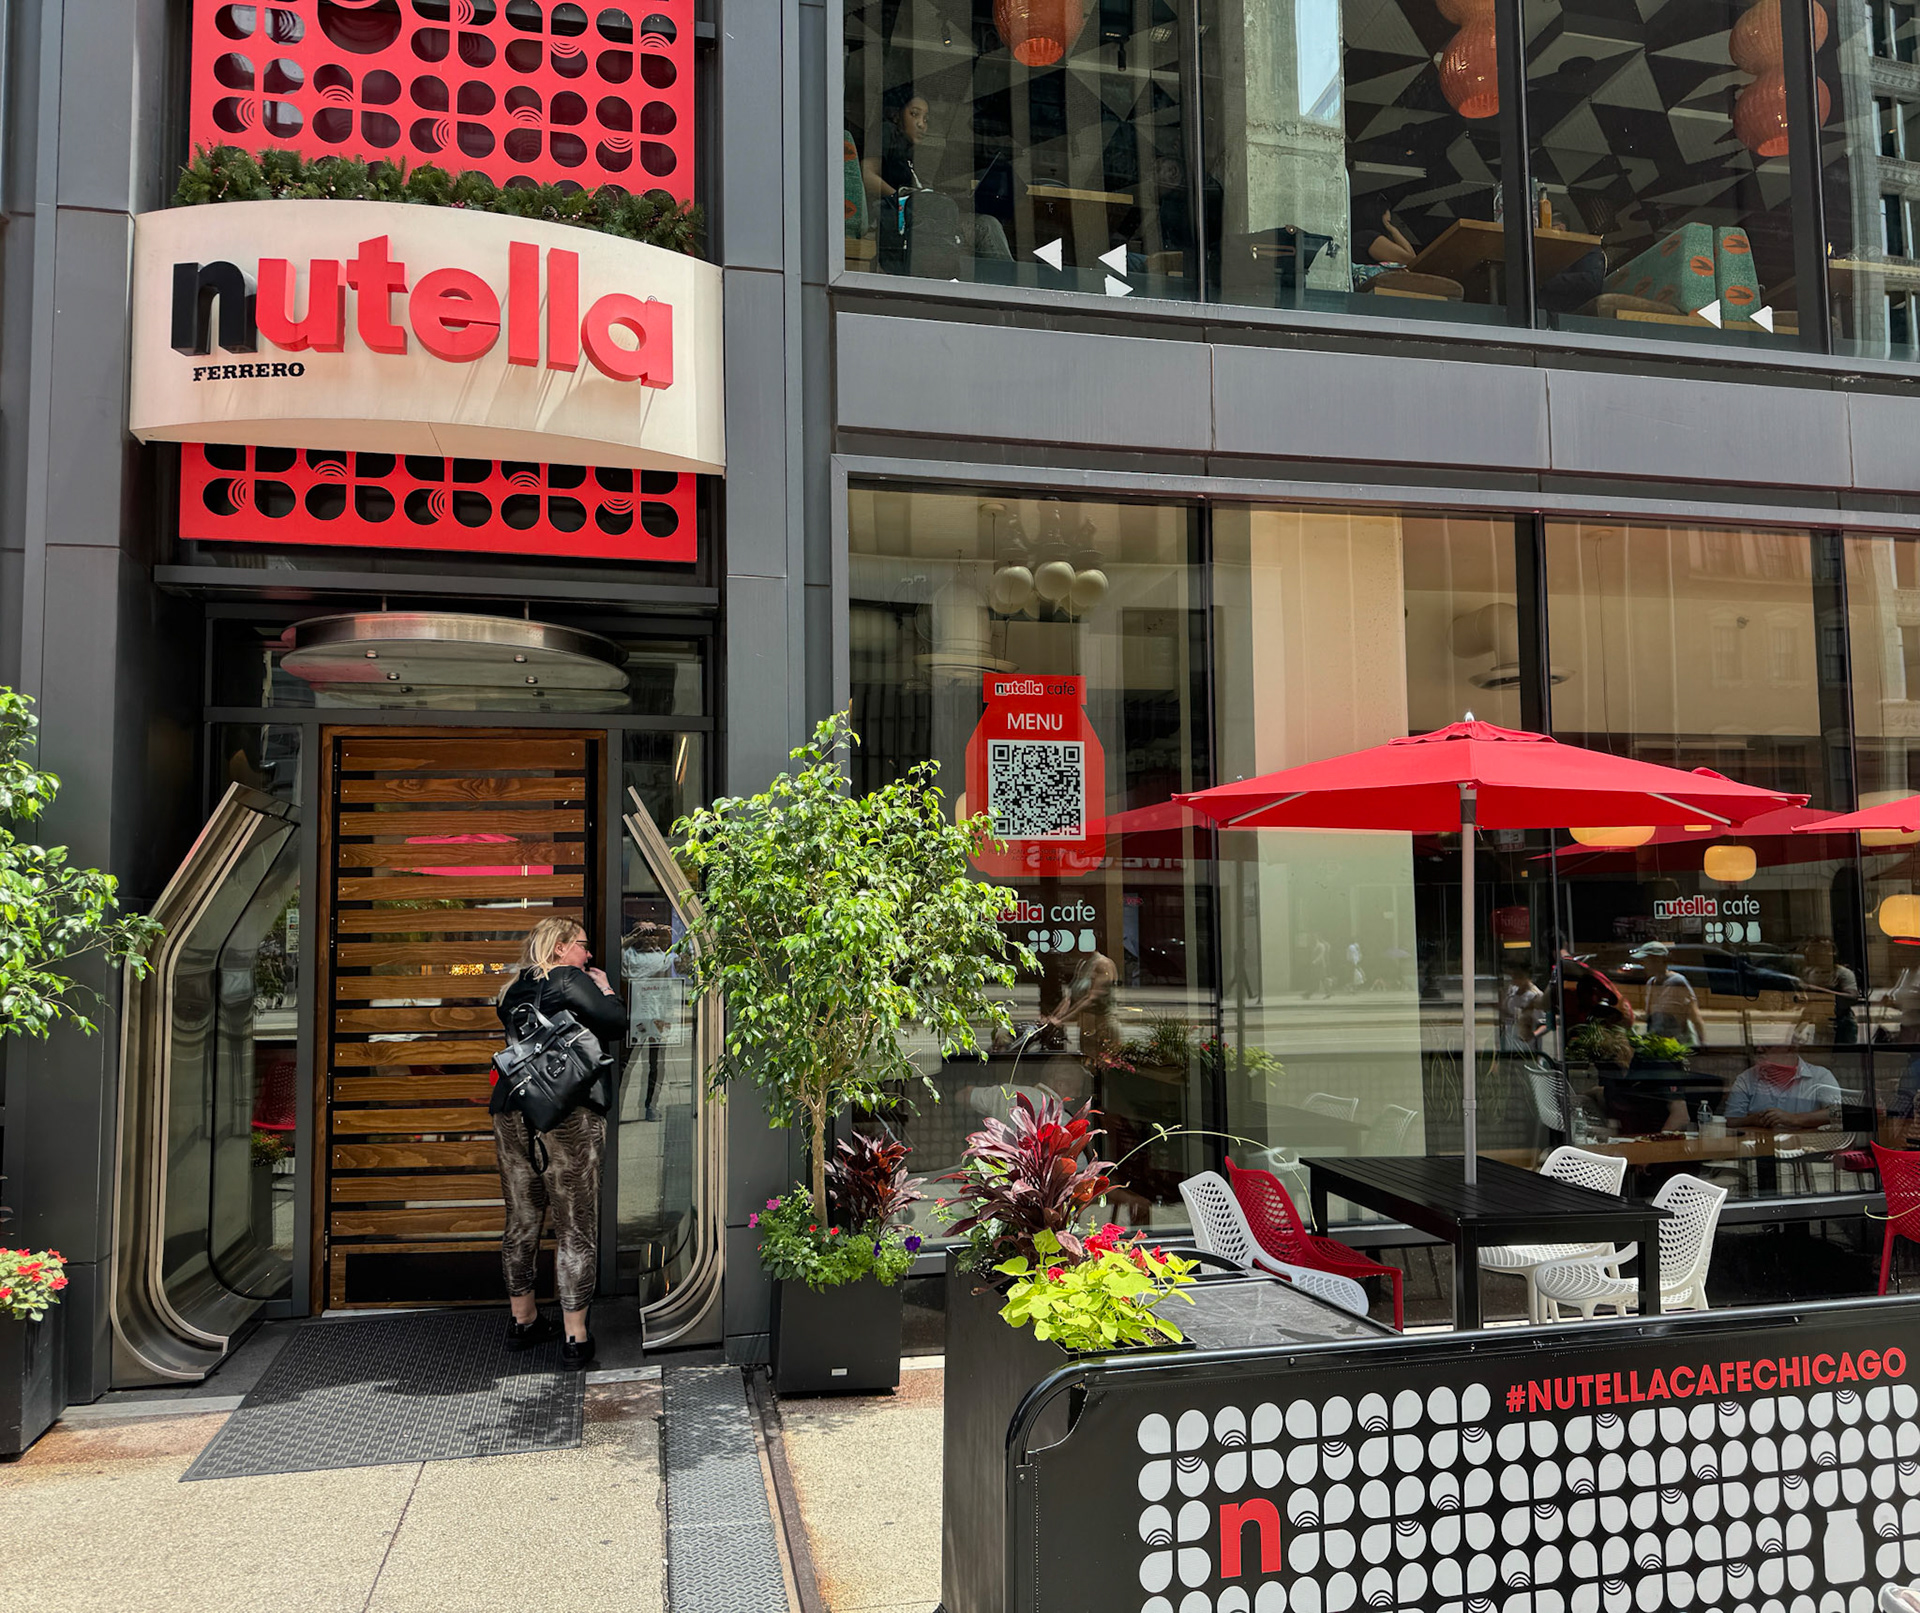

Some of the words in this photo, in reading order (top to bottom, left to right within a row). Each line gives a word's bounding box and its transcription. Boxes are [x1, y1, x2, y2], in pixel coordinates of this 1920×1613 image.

[171, 234, 674, 390] nutella
[193, 362, 306, 381] FERRERO
[995, 680, 1043, 695] nutella
[1046, 682, 1075, 695] cafe
[1007, 712, 1063, 731] MENU
[1050, 900, 1096, 922] cafe
[1654, 895, 1718, 918] nutella
[1722, 895, 1760, 915] cafe
[1506, 1346, 1907, 1413] #NUTELLACAFECHICAGO
[1220, 1498, 1281, 1579] n
